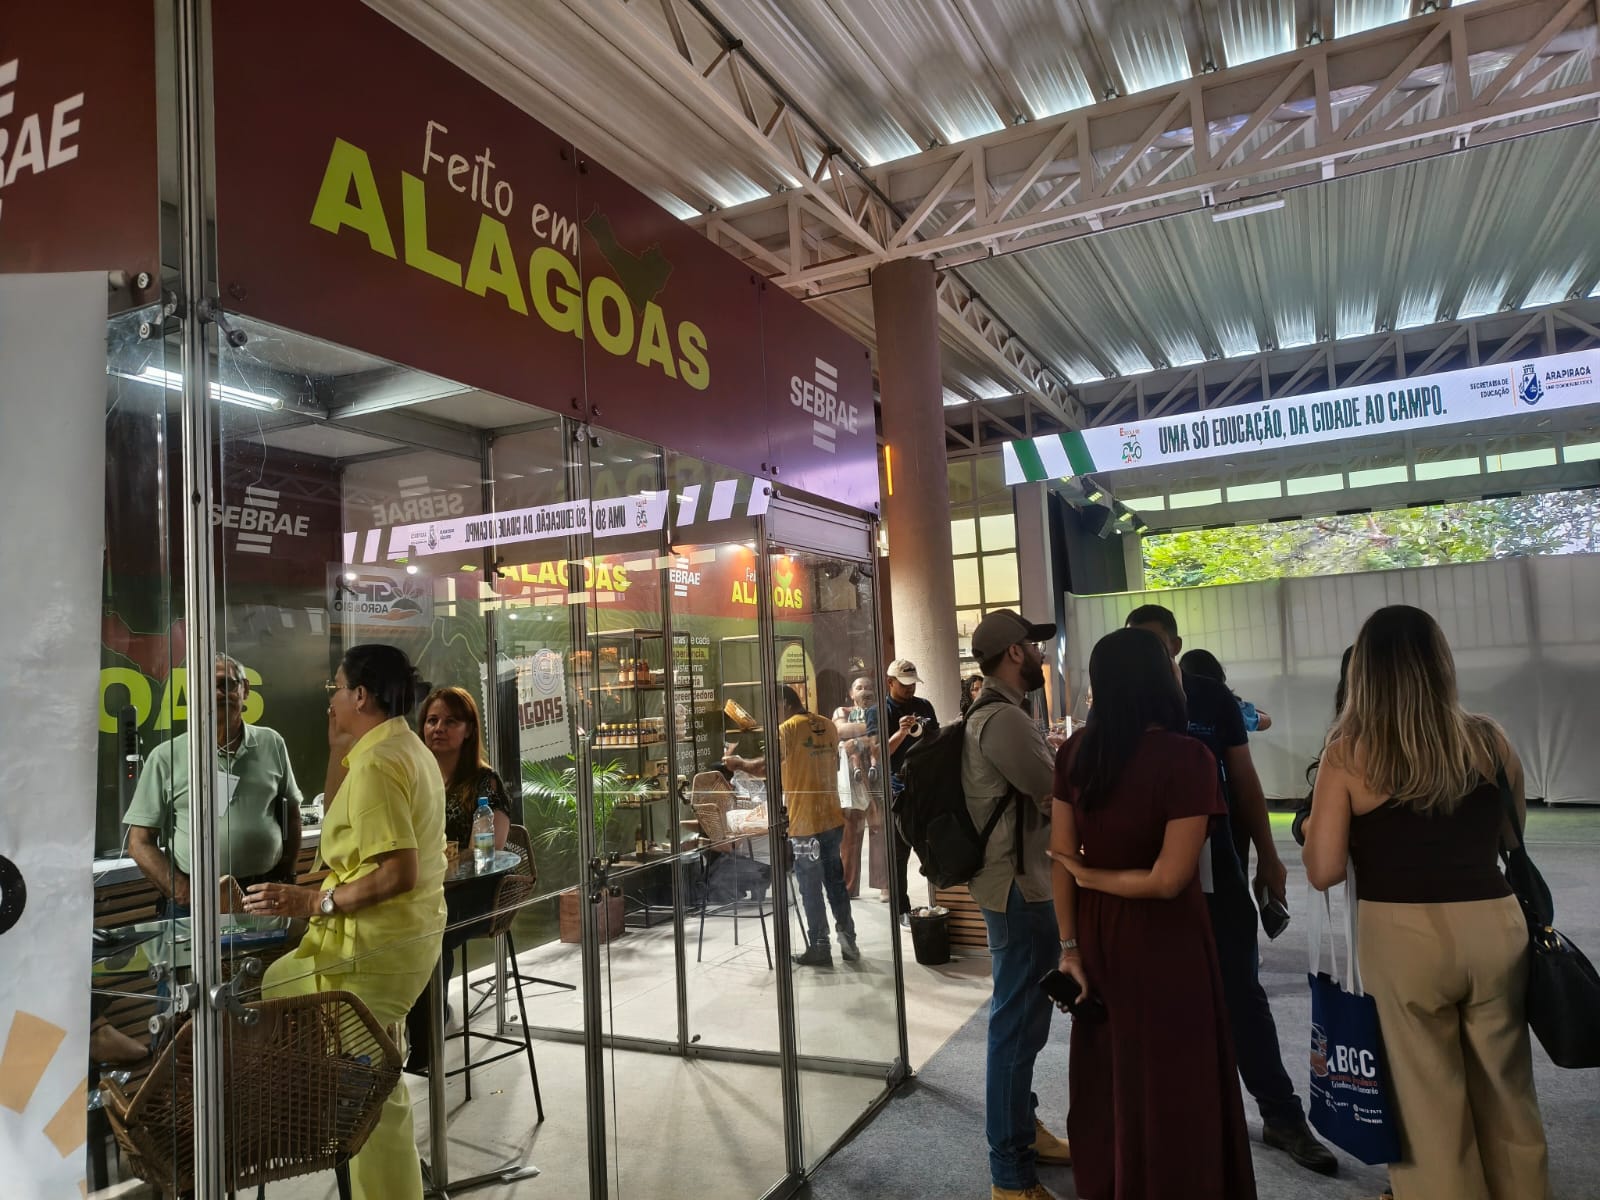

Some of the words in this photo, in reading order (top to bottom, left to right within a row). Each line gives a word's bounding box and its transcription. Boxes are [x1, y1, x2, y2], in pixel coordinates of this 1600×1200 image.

[422, 120, 513, 217] Feito
[531, 203, 579, 257] em
[309, 137, 710, 391] ALAGOAS
[1470, 379, 1501, 390] SECRETARIA
[1545, 365, 1592, 381] ARAPIRACA
[790, 375, 858, 435] SEBRAE
[1480, 387, 1510, 398] EDUCAÇÃO
[1158, 423, 1190, 454] UMA
[1192, 416, 1210, 450] SÓ
[1212, 405, 1287, 447] EDUCAÇÃO,
[1288, 405, 1309, 436] DA
[1311, 397, 1362, 433] CIDADE
[1365, 393, 1385, 425] AO
[1387, 384, 1448, 422] CAMPO.
[210, 504, 310, 537] SEBRAE
[669, 569, 700, 586] EBRAE
